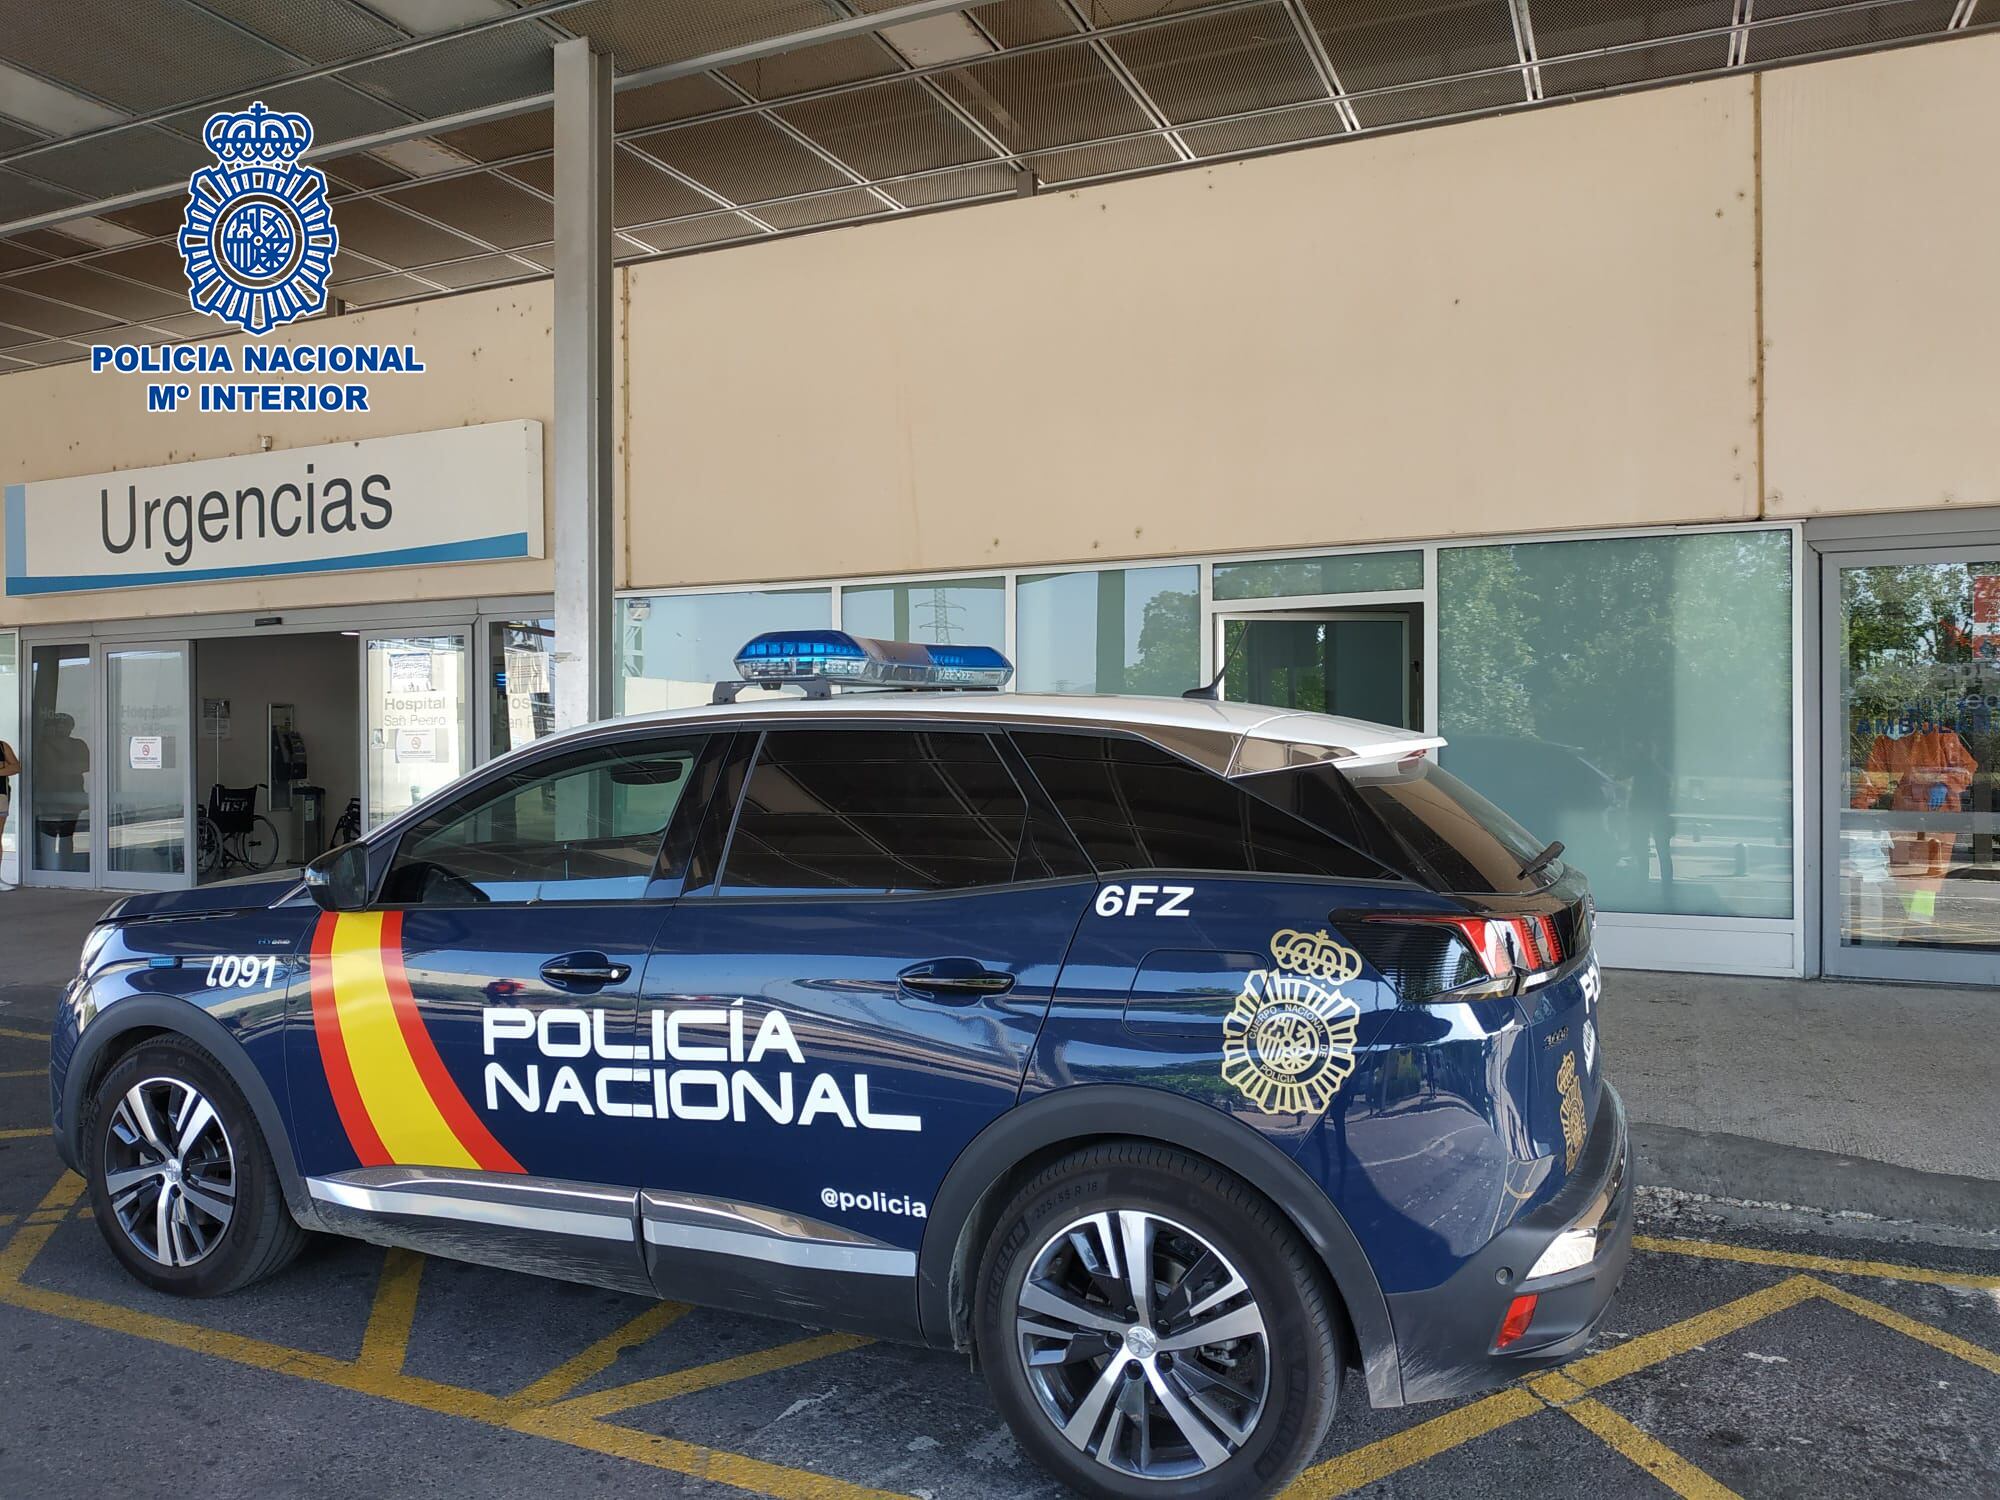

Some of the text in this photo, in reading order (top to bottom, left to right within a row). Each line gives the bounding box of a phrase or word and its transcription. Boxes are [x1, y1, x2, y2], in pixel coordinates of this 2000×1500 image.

[101, 463, 393, 566] Urgencias
[383, 696, 447, 713] Hospital
[384, 713, 447, 727] San Pedro
[1095, 884, 1195, 917] 6FZ
[218, 955, 277, 989] 091
[482, 996, 806, 1064] POLICÍA
[1248, 1003, 1329, 1059] CUERPO NACIONAL DE
[1259, 1063, 1298, 1083] POLICIA
[484, 1061, 923, 1132] NACIONAL
[820, 1187, 928, 1219] @policia
[1074, 1185, 1082, 1197] R
[1086, 1181, 1098, 1192] 18
